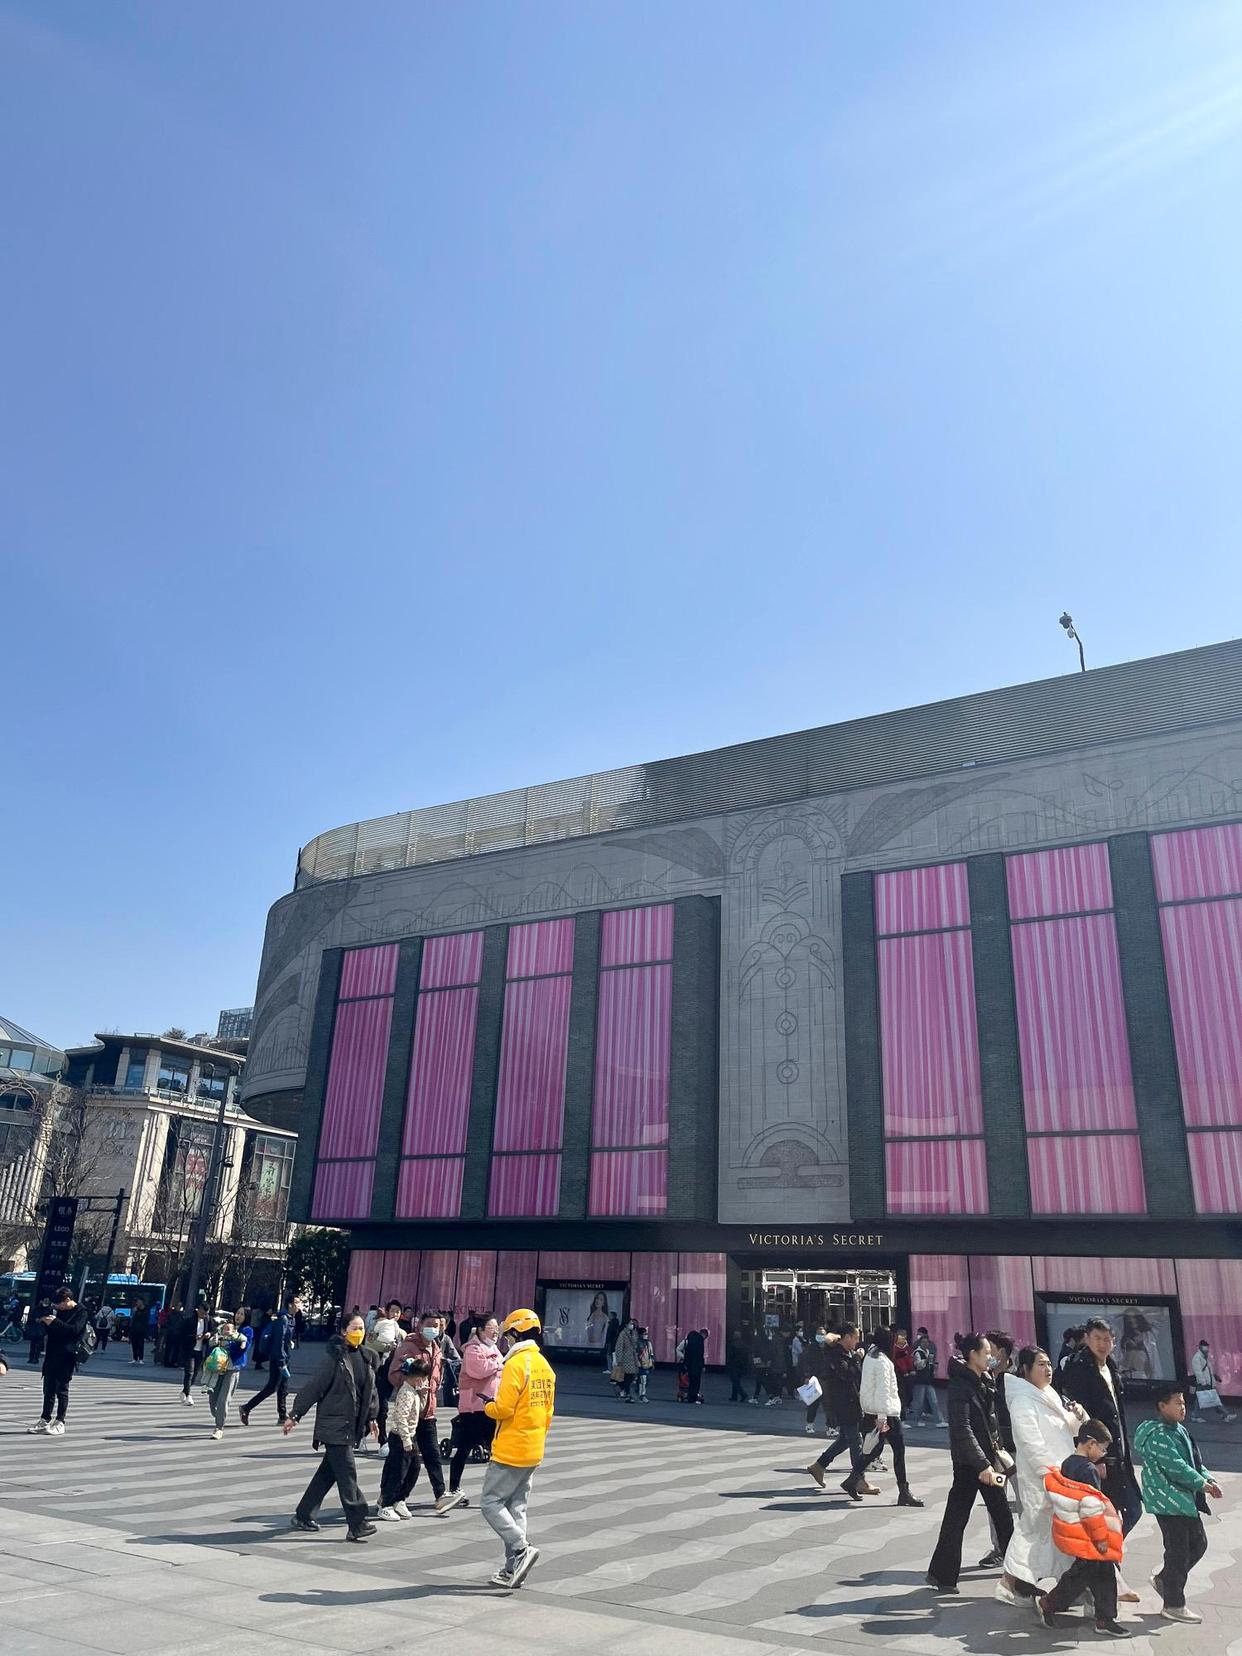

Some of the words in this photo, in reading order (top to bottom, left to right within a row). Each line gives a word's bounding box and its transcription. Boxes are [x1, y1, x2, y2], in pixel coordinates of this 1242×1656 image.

[749, 1233, 824, 1246] VICTORIA'S
[832, 1233, 883, 1246] SECRET
[1069, 1296, 1110, 1304] VICTORIA'S
